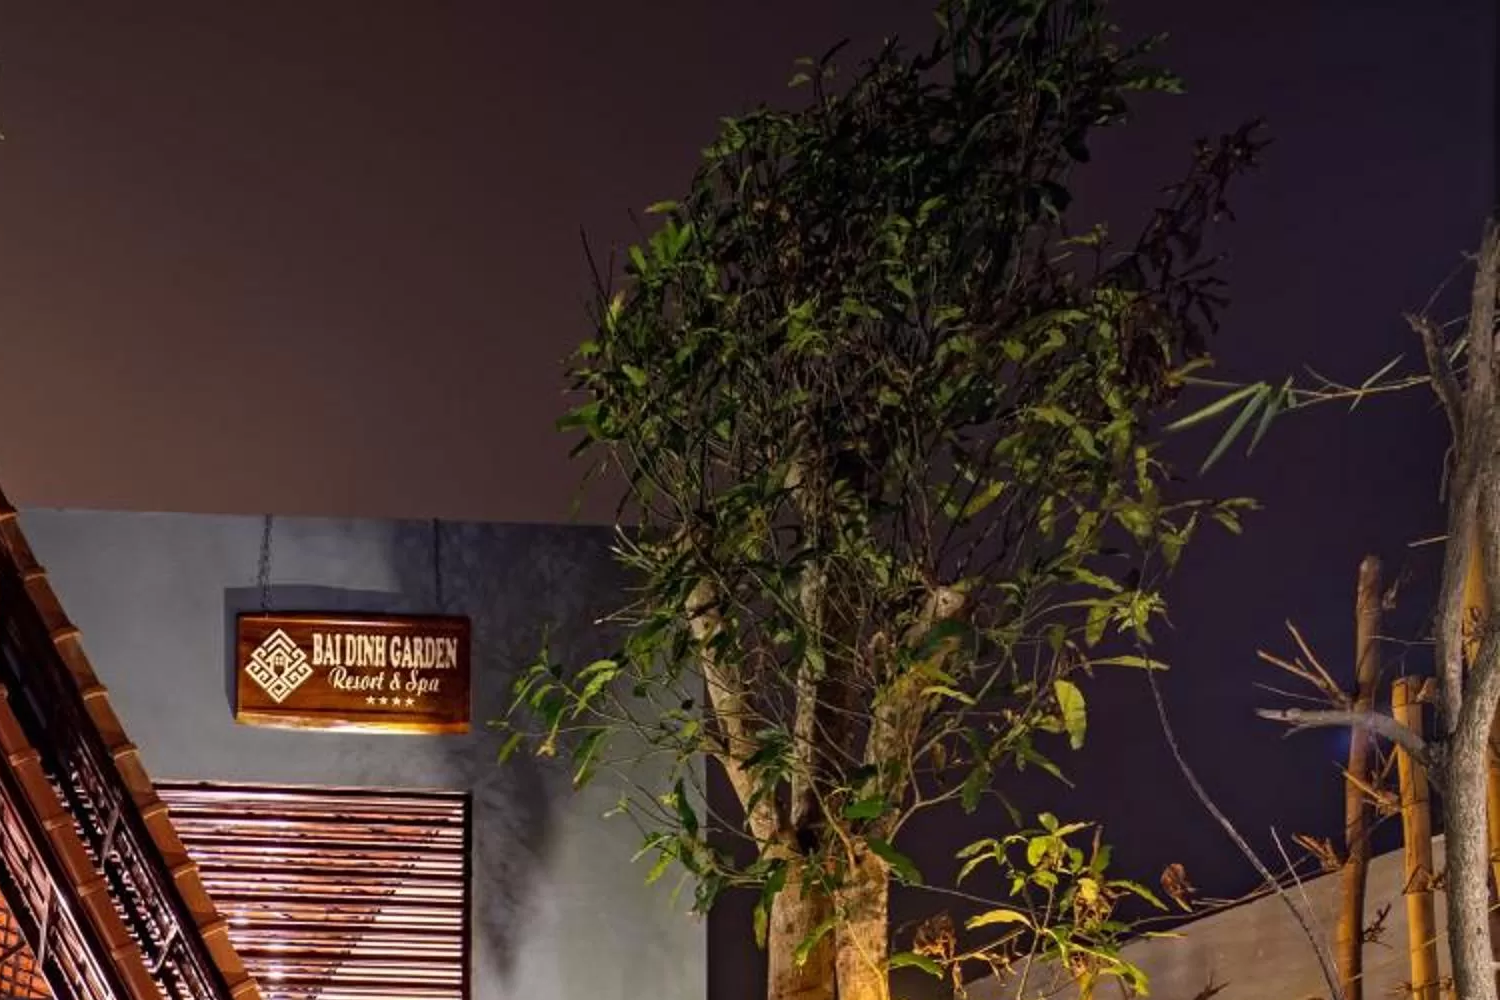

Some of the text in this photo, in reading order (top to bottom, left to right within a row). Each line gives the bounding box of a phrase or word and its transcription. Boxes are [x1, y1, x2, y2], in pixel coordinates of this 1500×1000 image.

[312, 633, 458, 669] BAI DINH GARDEN
[328, 666, 440, 696] Resort & Spa
